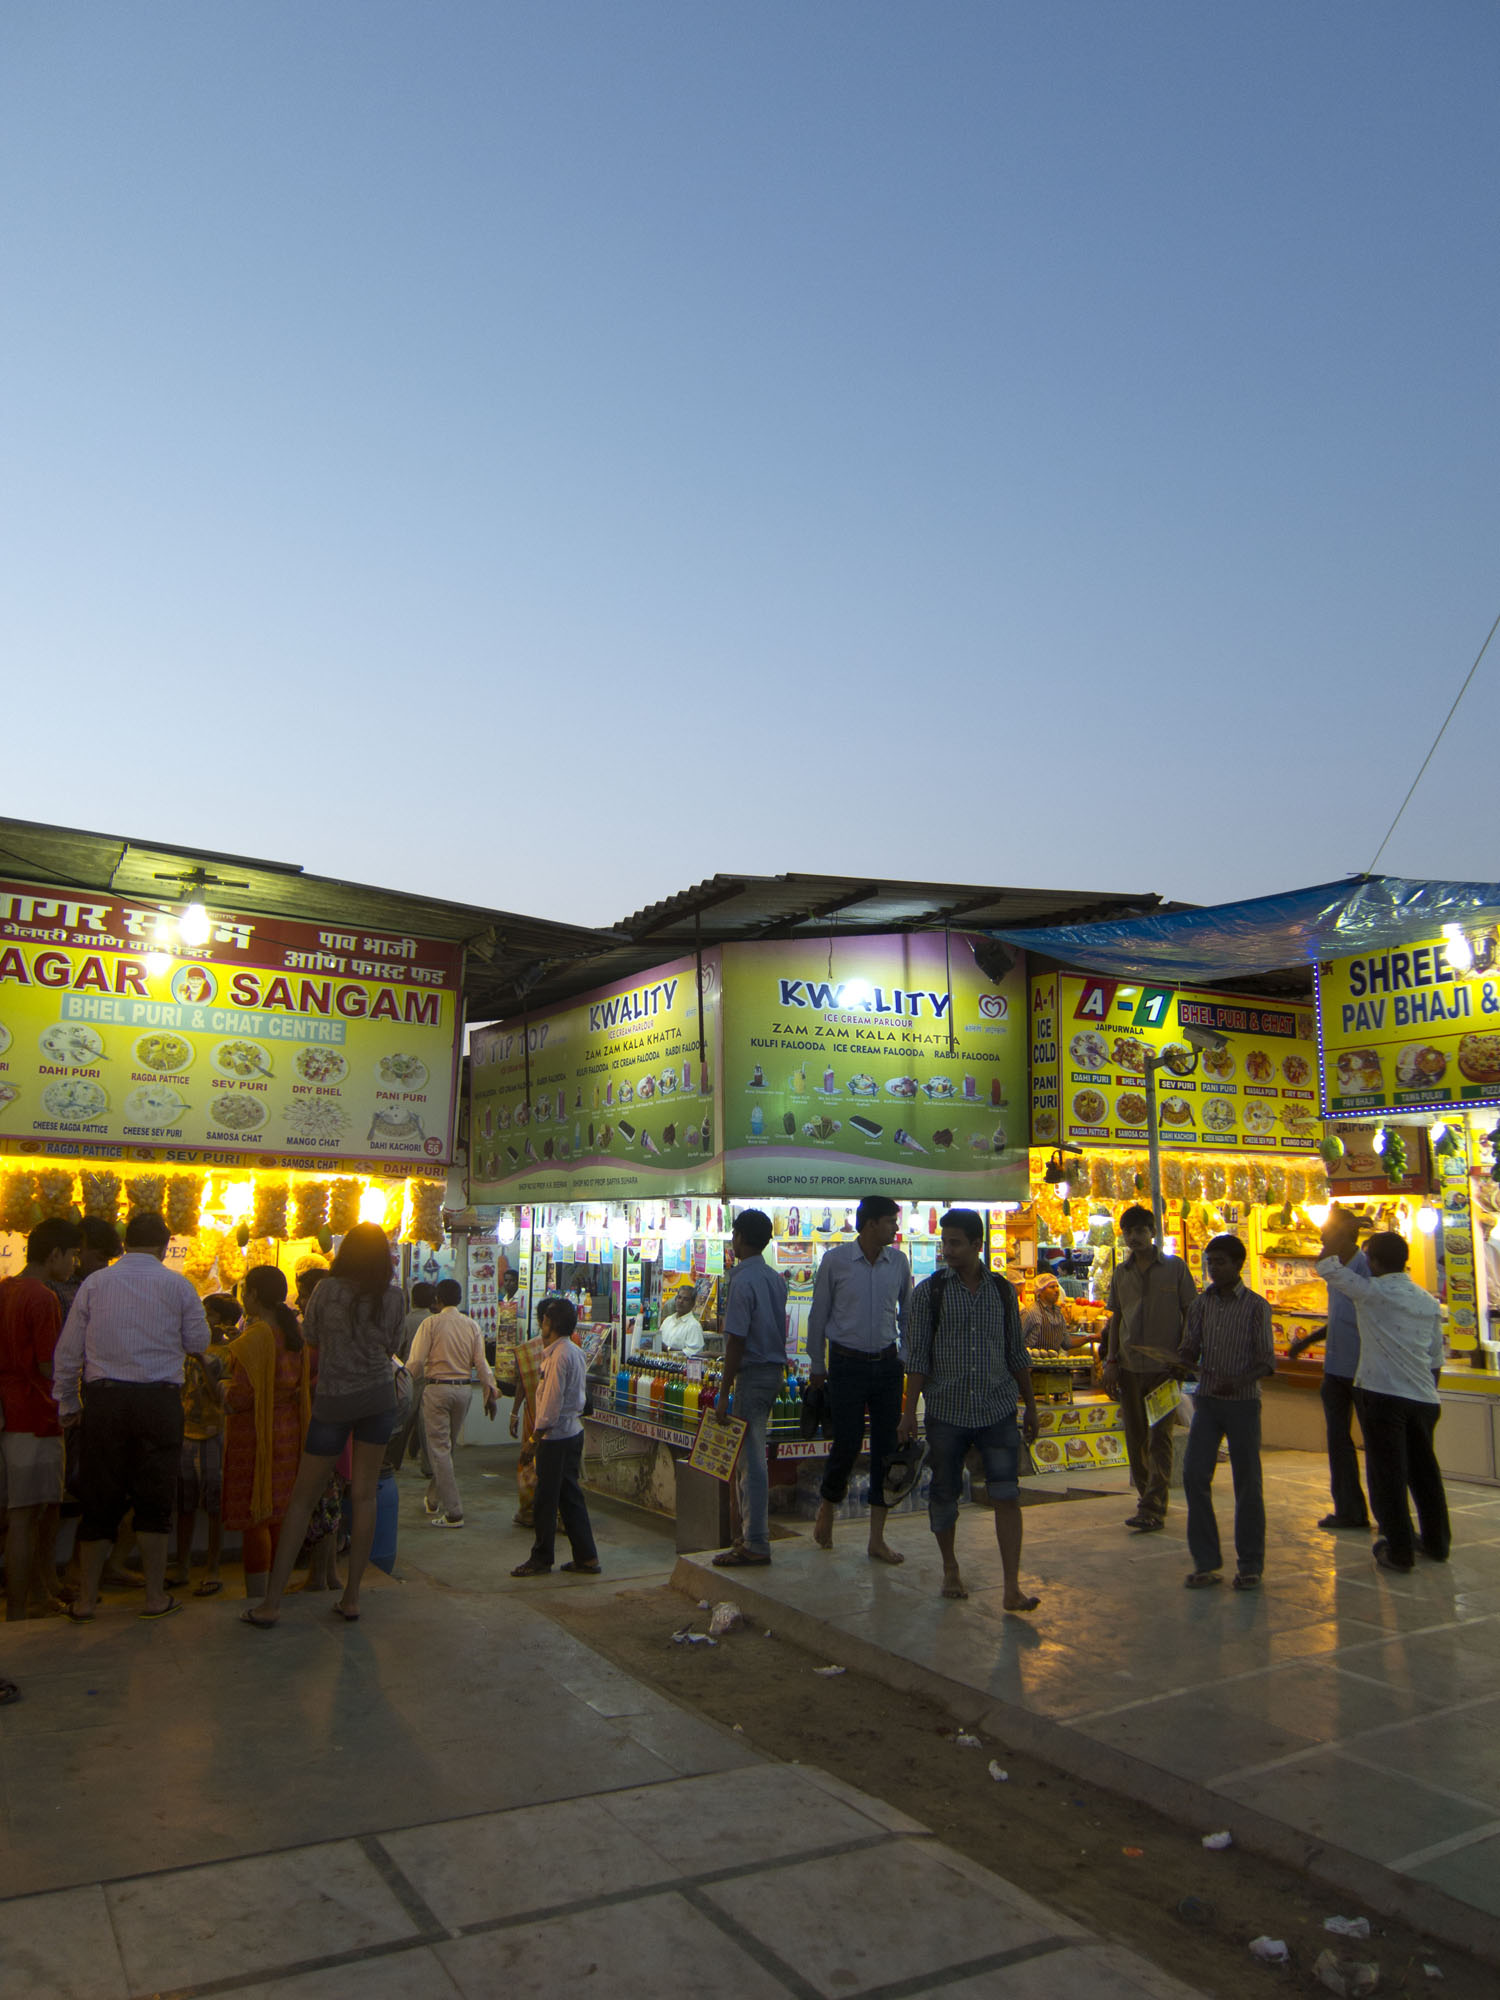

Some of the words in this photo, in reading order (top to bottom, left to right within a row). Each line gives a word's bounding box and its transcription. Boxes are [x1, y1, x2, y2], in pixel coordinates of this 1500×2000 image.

[318, 931, 358, 951] पाव
[363, 936, 418, 959] भाजी
[1349, 945, 1454, 997] SHREE
[229, 971, 440, 1027] SANGAM
[589, 978, 678, 1032] KWALITY
[1033, 984, 1055, 1012] A-1
[1342, 997, 1386, 1033] PAV
[1394, 985, 1471, 1027] BHAJI
[1481, 982, 1500, 1014] &
[69, 996, 125, 1022] BHEL
[132, 1003, 182, 1027] PURI
[191, 1009, 205, 1029] &
[211, 1011, 264, 1035] CHAT
[268, 1018, 343, 1042] CENTRE
[823, 1013, 838, 1023] ICE
[840, 1015, 872, 1026] CREAM
[874, 1017, 913, 1028] PARLOUR
[1181, 1004, 1215, 1026] BHEL
[1217, 1009, 1247, 1029] PURI
[1250, 1012, 1260, 1030] &
[1261, 1013, 1294, 1034] CHAT
[608, 1030, 616, 1039] ICE
[616, 1026, 632, 1038] CREAM
[632, 1020, 654, 1033] PARLOUR
[772, 1022, 809, 1036] ZAM
[814, 1026, 850, 1038] ZAM
[855, 1028, 896, 1041] KALA
[902, 1032, 961, 1046] KHATTA
[1037, 1018, 1052, 1039] ICE
[1094, 1023, 1145, 1035] JAIPURWALA
[585, 1049, 602, 1061] ZAM
[603, 1044, 621, 1057] ZAM
[623, 1037, 645, 1052] KALA
[647, 1027, 682, 1045] KHATTA
[751, 1038, 778, 1048] KULFI
[781, 1040, 826, 1052] FALOODA
[833, 1043, 848, 1053] ICE
[850, 1045, 881, 1054] CREAM
[883, 1047, 925, 1057] FALOODA
[934, 1050, 959, 1060] RABDI
[961, 1052, 1000, 1062] FALOODA
[612, 1060, 620, 1069] ICE
[620, 1056, 636, 1068] CREAM
[636, 1052, 660, 1065] FALOODA
[682, 1039, 708, 1053] FALOOA
[1033, 1042, 1056, 1064] COLD
[39, 1065, 68, 1076] DAHI
[72, 1068, 101, 1078] PURI
[131, 1072, 157, 1082] RAGDA
[159, 1075, 190, 1085] PATTICE
[1073, 1073, 1091, 1082] DAHI
[1092, 1075, 1109, 1083] PURI
[211, 1078, 236, 1089] SEV
[239, 1080, 268, 1091] PURI
[1033, 1075, 1057, 1091] PANI
[1121, 1077, 1136, 1085] BHEL
[1161, 1080, 1176, 1089] SEV
[1177, 1082, 1195, 1090] PURI
[1202, 1083, 1219, 1092] PANI
[1220, 1085, 1236, 1093] PURI
[292, 1085, 314, 1095] DRY
[316, 1086, 342, 1097] BHEL
[375, 1091, 400, 1101] PANI
[403, 1092, 427, 1103] PURI
[1033, 1095, 1058, 1110] PURI
[33, 1120, 59, 1131] CHEESE
[61, 1122, 81, 1133] RAGDA
[82, 1124, 108, 1134] PATTICE
[123, 1126, 149, 1137] CHEESE
[151, 1128, 165, 1137] SEV
[166, 1128, 182, 1138] PURI
[1117, 1128, 1138, 1137] SAMOSA
[1139, 1130, 1149, 1138] CHA
[206, 1131, 239, 1141] SAMOSA
[241, 1133, 262, 1143] CHAT
[286, 1136, 317, 1146] MANGO
[318, 1138, 340, 1147] CHAT
[1301, 1139, 1313, 1147] CHAT
[46, 1143, 80, 1156] RAGDA
[82, 1145, 122, 1158] PATTICE
[370, 1141, 387, 1150] DAHI
[389, 1142, 421, 1152] KACHORI
[427, 1144, 440, 1154] 56
[166, 1150, 198, 1162] SEV
[203, 1152, 240, 1165] PURI
[281, 1157, 315, 1169] SAMOSA
[317, 1159, 338, 1171] CHAT
[383, 1163, 412, 1175] DAHI
[416, 1165, 445, 1177] PURI
[767, 1176, 792, 1184] SHOP
[794, 1176, 807, 1184] NO
[809, 1176, 819, 1184] 57
[821, 1176, 845, 1185] PROP.
[848, 1176, 878, 1185] SAFIYA
[879, 1177, 913, 1185] SUHARA
[622, 1416, 631, 1430] ICE
[656, 1426, 672, 1441] MILK
[673, 1430, 690, 1446] MAID
[776, 1443, 816, 1457] HATTA
